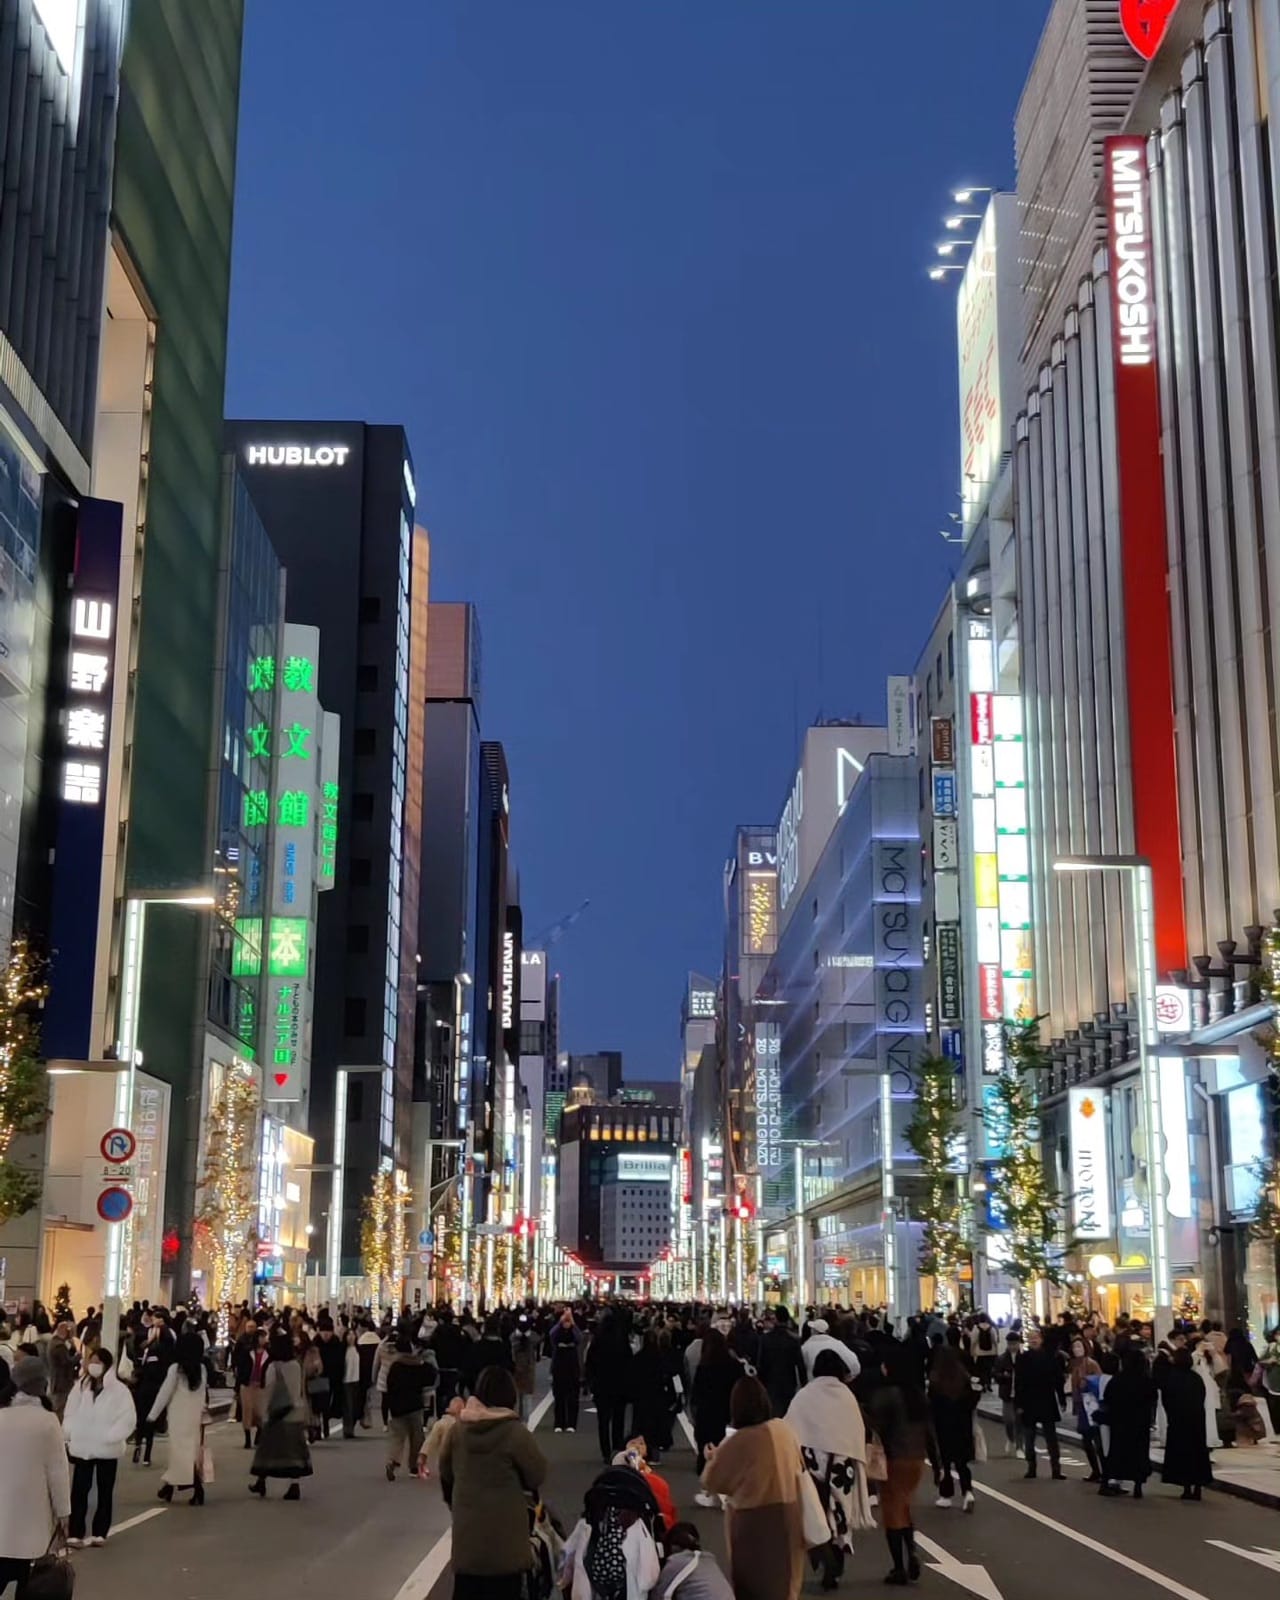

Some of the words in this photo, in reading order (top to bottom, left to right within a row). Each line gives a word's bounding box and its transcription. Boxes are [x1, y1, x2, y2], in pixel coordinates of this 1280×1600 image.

[1111, 150, 1151, 365] MITSUKOSHI
[248, 446, 349, 466] HUBLOT
[64, 598, 111, 804] 山野楽器
[278, 656, 314, 827] 教文館
[271, 927, 302, 967] 本
[623, 1160, 666, 1170] Brillia
